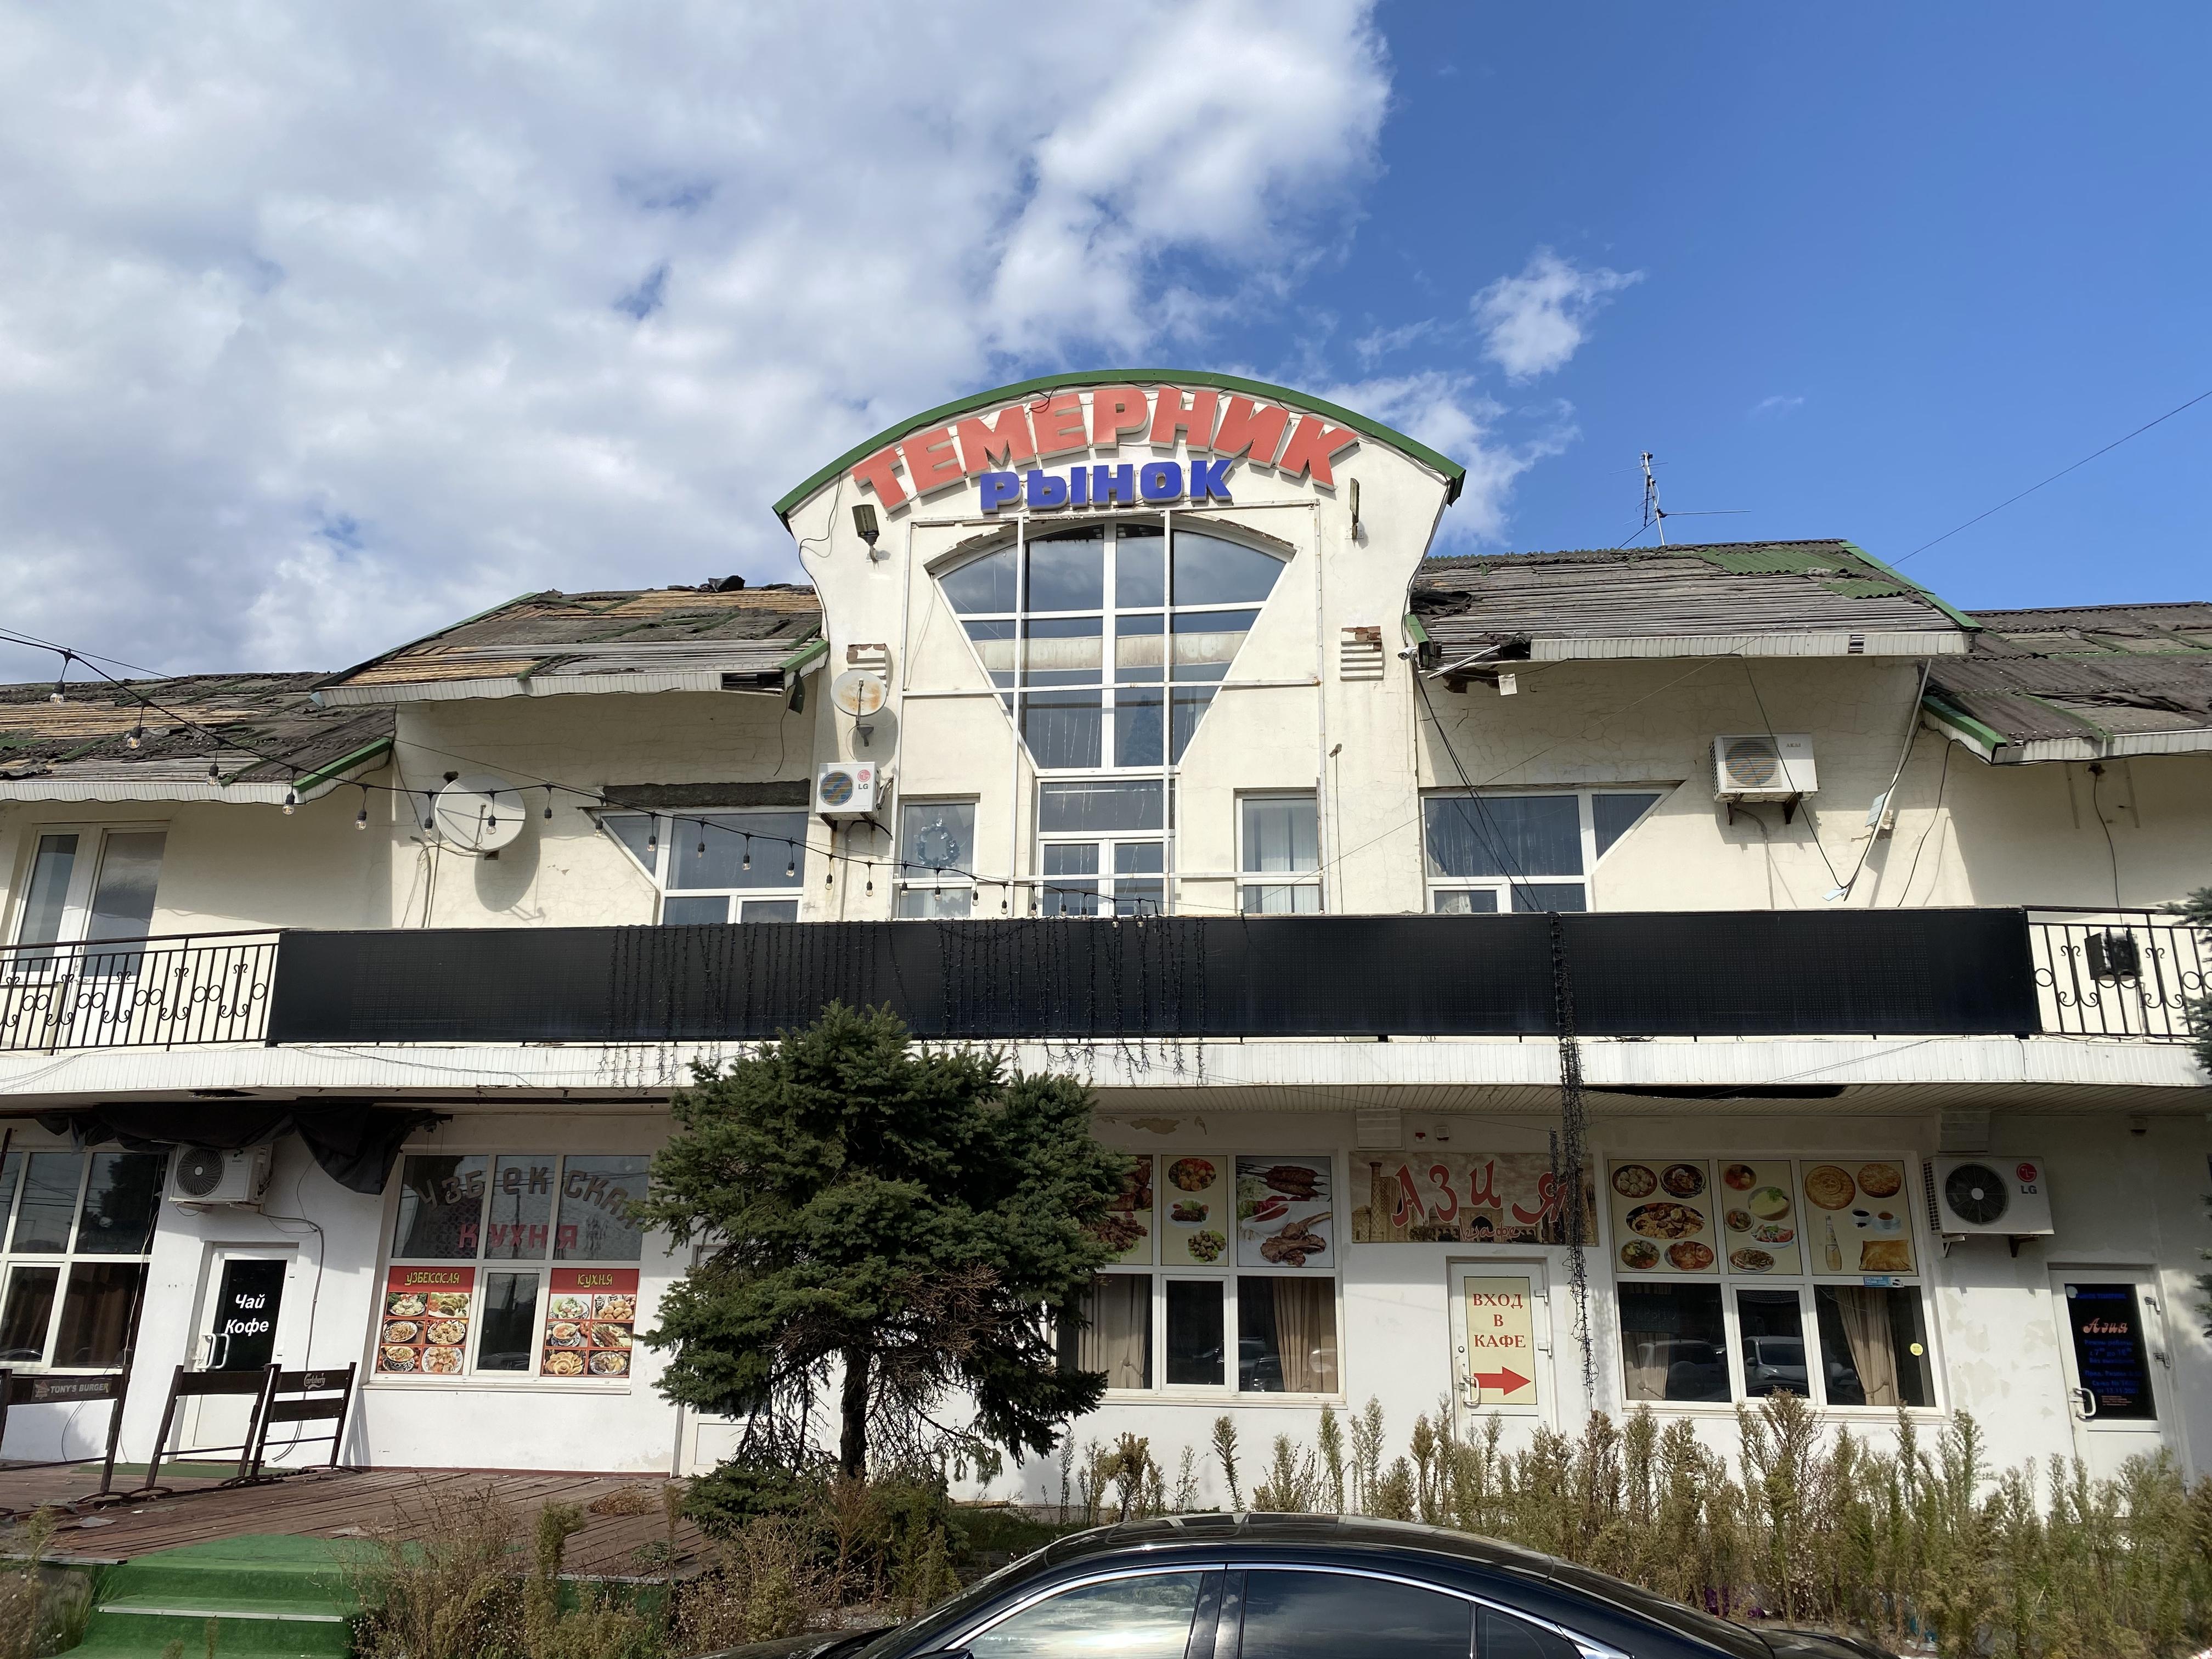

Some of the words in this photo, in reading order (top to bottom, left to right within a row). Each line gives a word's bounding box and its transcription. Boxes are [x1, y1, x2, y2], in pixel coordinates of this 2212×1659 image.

[851, 387, 1358, 514] ТЕМЕРНИК
[980, 459, 1232, 514] РЫНОК
[2021, 1185, 2037, 1194] LG
[459, 1224, 578, 1249] КУХНЯ
[235, 1294, 266, 1308] Чай
[1472, 1294, 1523, 1309] ВХОД
[224, 1318, 269, 1336] Кофе
[1493, 1314, 1504, 1327] В
[1474, 1334, 1526, 1348] КАФЕ
[50, 1385, 77, 1393] TONY'S
[79, 1383, 109, 1392] BURGER
